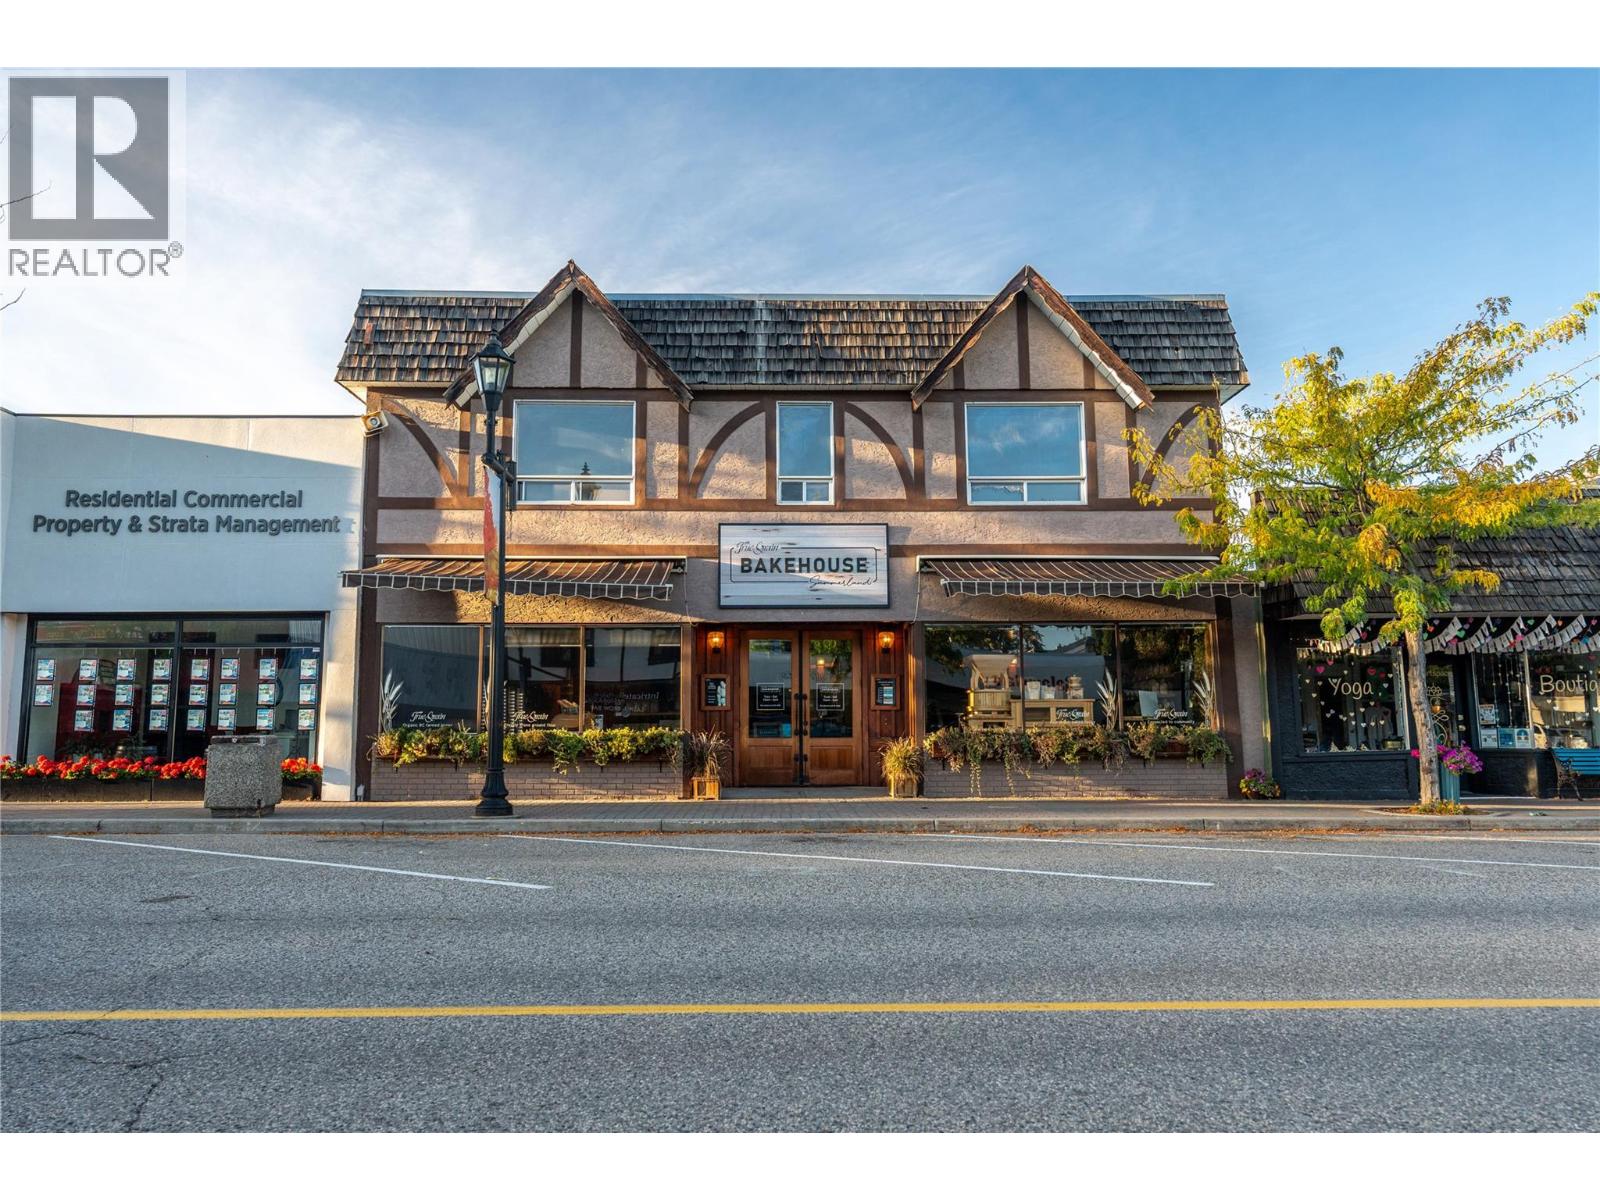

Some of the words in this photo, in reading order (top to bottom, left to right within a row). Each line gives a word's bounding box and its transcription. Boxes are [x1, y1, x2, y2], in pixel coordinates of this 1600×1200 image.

[65, 489, 177, 508] Residential
[183, 489, 303, 508] Commercial
[32, 514, 122, 537] Property
[127, 515, 142, 533] &
[148, 514, 209, 533] Strata
[215, 514, 341, 537] Management
[740, 557, 868, 574] BAKEHOUSE
[1328, 677, 1374, 700] Yoga
